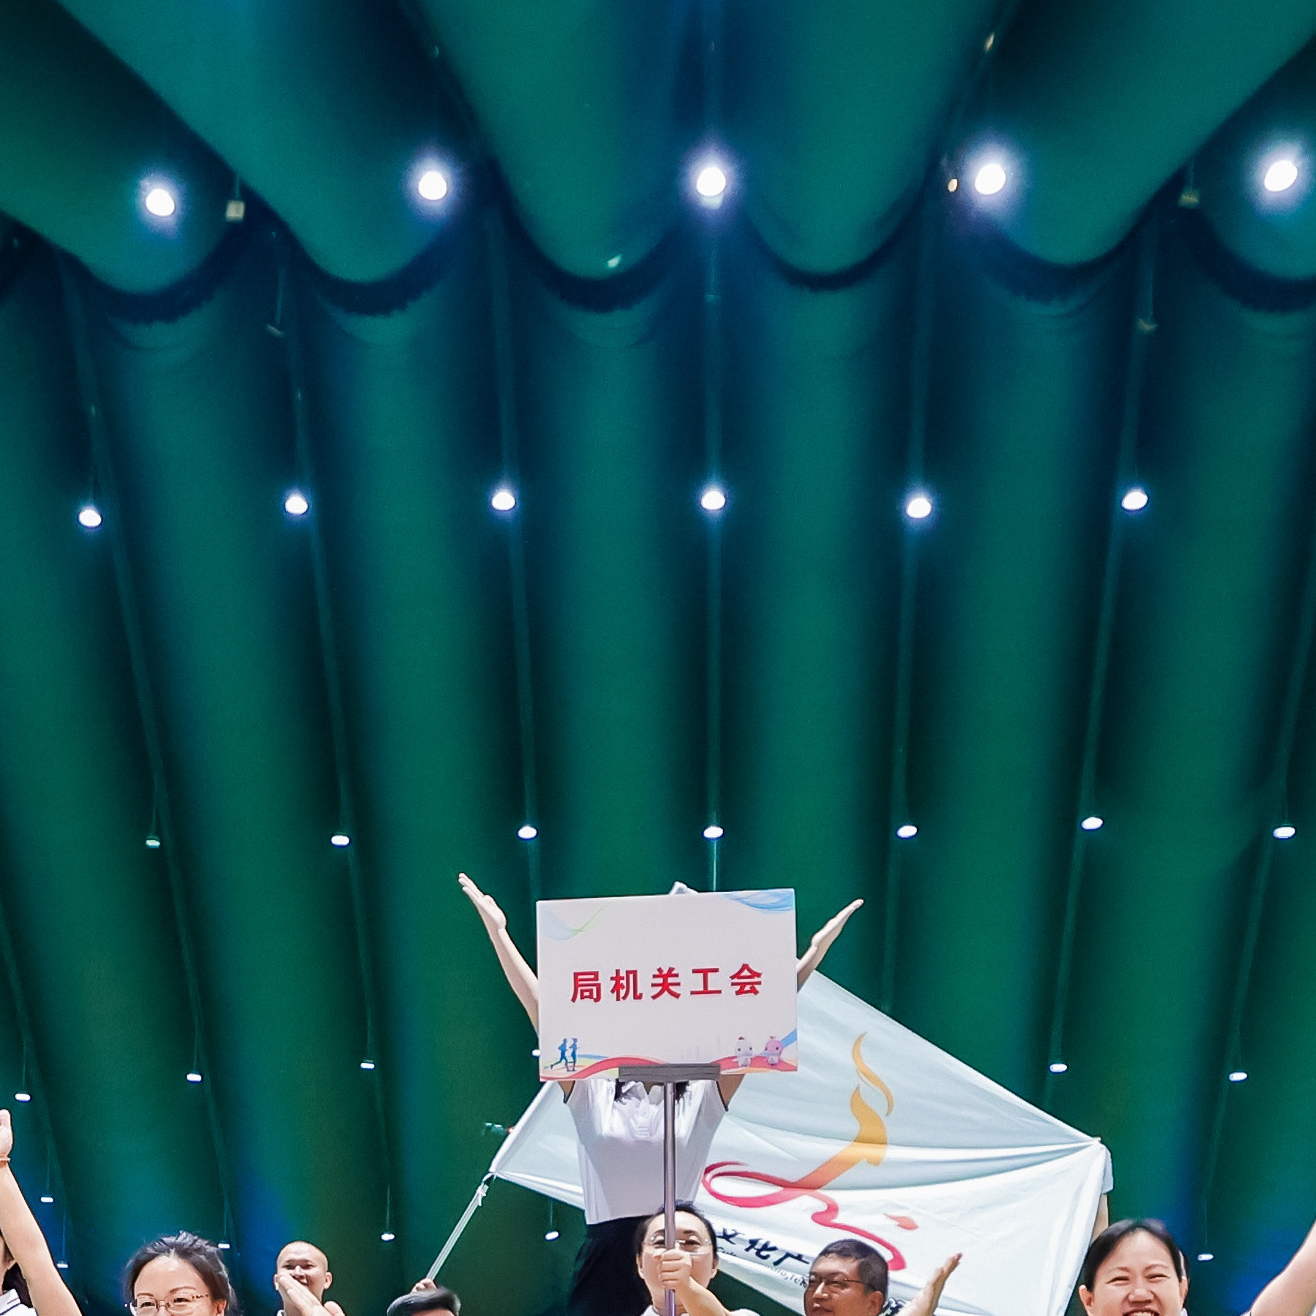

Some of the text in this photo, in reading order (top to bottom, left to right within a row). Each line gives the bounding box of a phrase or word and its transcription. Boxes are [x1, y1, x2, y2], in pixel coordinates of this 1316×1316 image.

[571, 963, 763, 1003] 局机关工会
